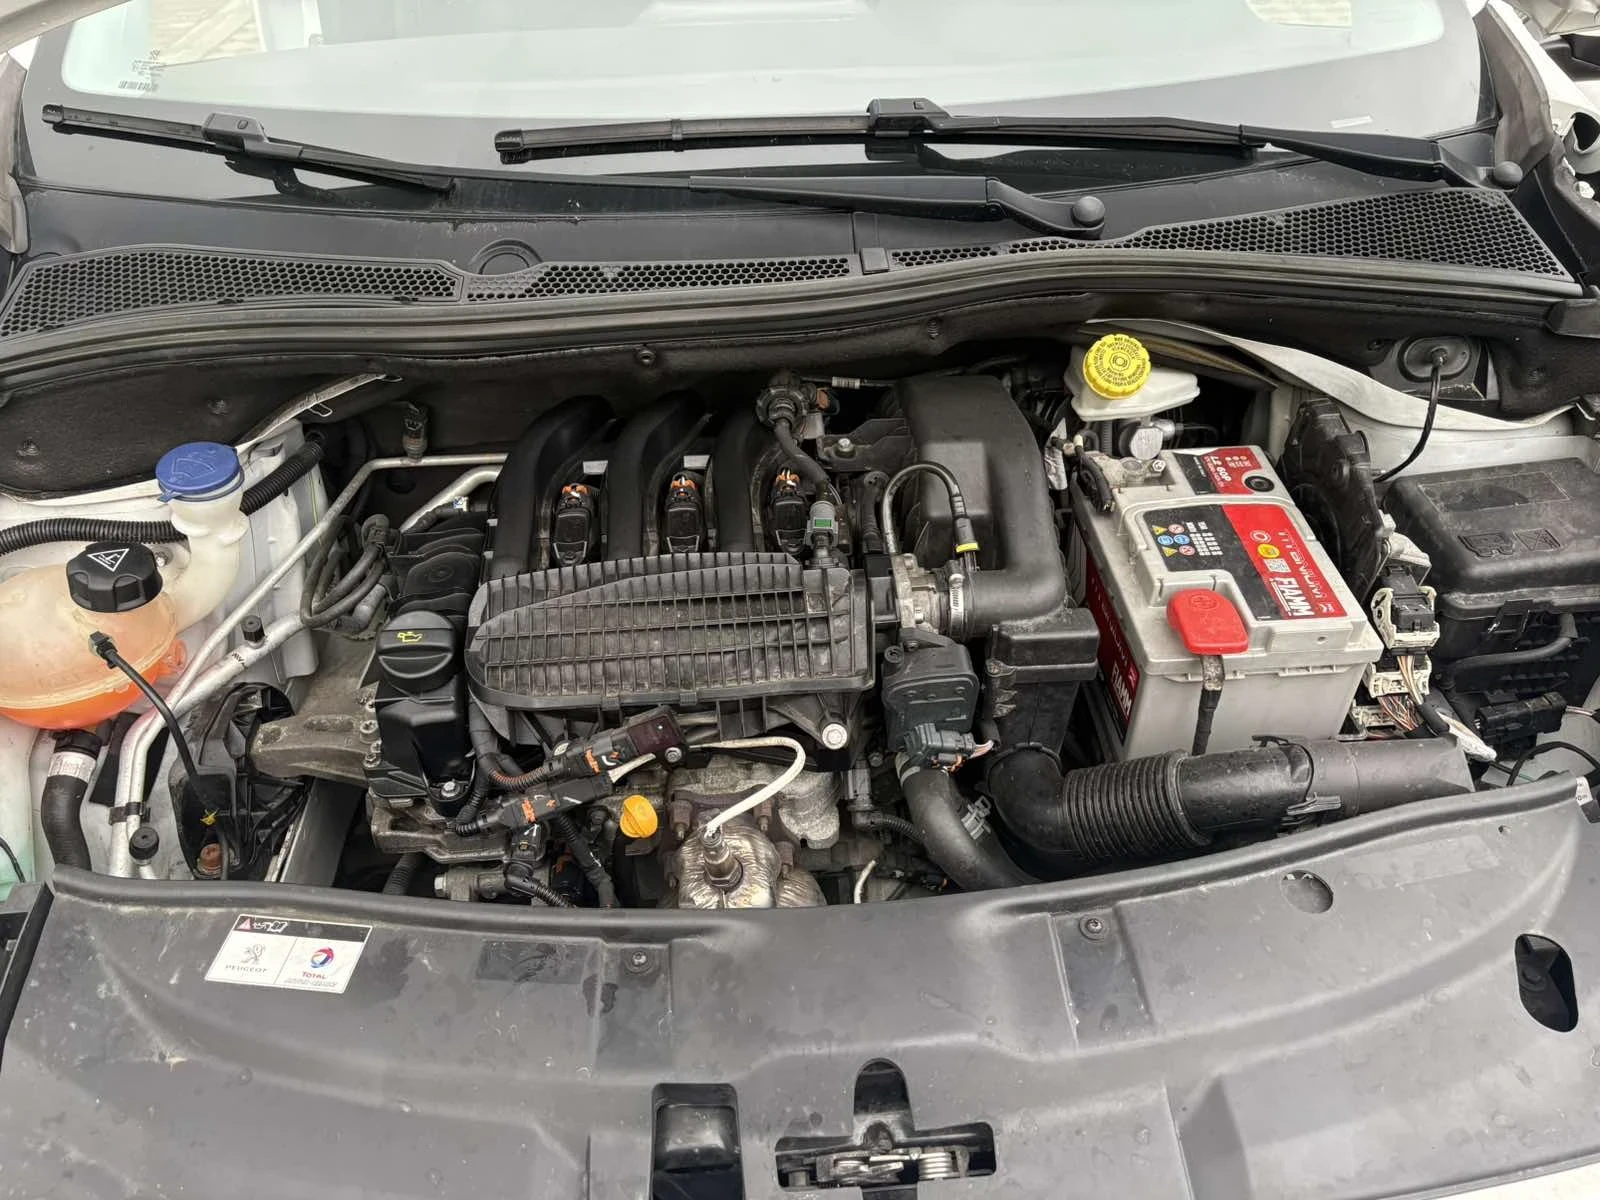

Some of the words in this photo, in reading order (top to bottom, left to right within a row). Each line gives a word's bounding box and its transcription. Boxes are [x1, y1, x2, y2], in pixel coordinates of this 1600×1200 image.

[1275, 577, 1315, 616] FIAMM
[1112, 660, 1132, 713] FIAMM
[225, 964, 267, 973] PEUGEOT
[302, 971, 326, 980] TOTAL
